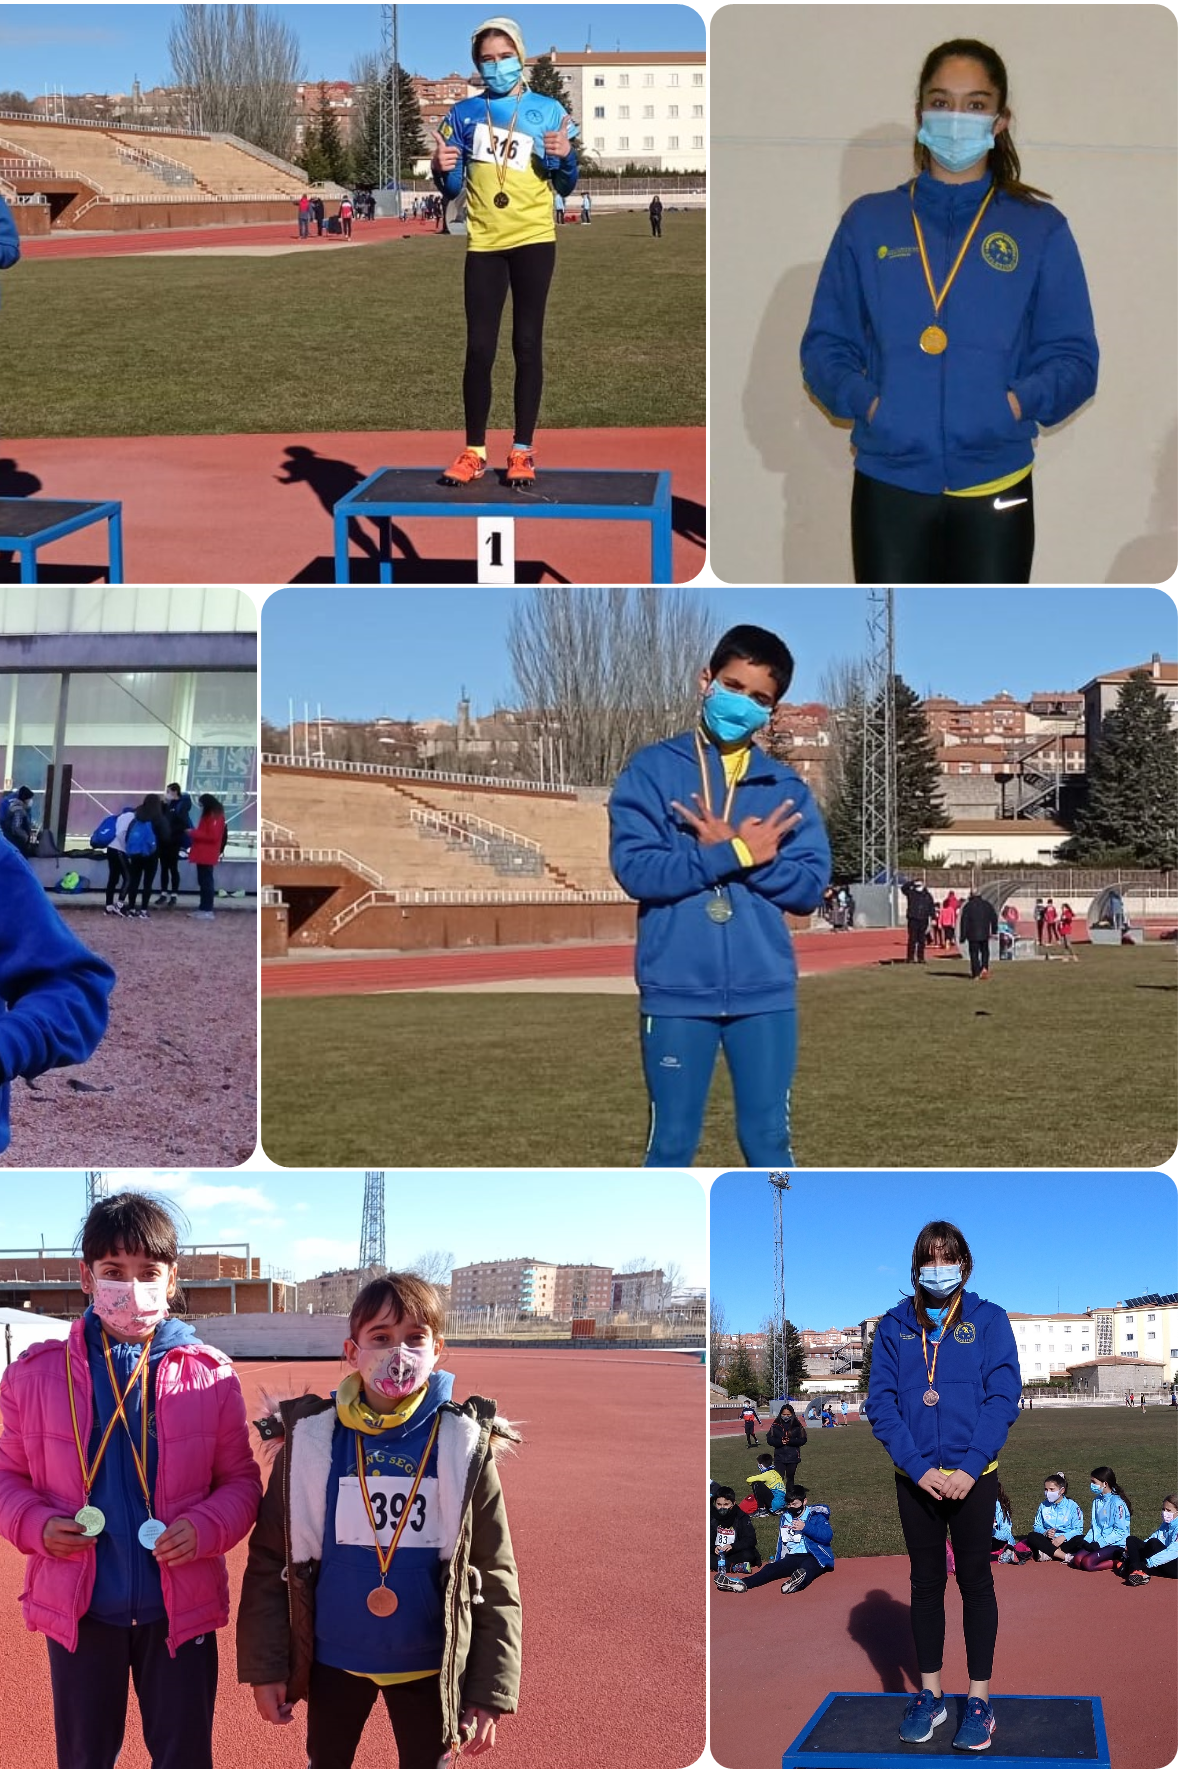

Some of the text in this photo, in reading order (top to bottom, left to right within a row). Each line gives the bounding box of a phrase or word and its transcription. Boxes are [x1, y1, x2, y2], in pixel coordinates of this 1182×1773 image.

[486, 135, 519, 160] 316
[485, 532, 504, 566] 1
[370, 1492, 428, 1532] 393
